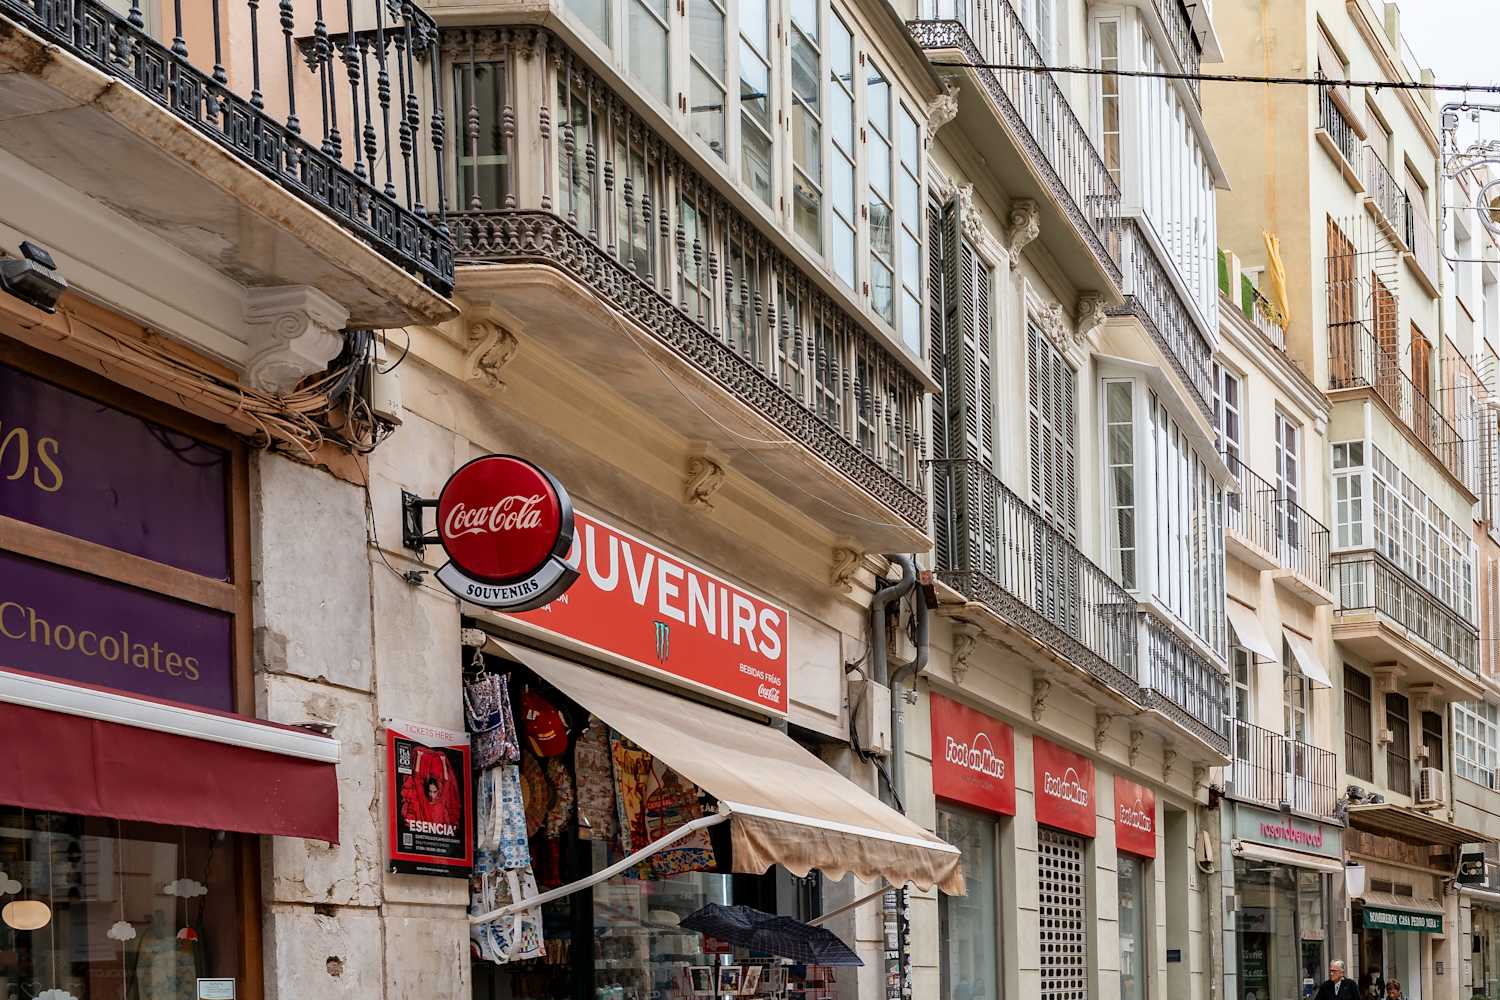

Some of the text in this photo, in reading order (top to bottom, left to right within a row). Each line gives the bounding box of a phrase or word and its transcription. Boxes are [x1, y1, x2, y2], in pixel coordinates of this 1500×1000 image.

[445, 493, 547, 540] Coca-Cola
[465, 578, 540, 599] SOUVENIRS
[567, 523, 782, 661] UVENIRS
[0, 601, 200, 681] Chocolates
[739, 663, 764, 680] BEBIDAS
[945, 735, 968, 767] Foot
[969, 748, 982, 772] on
